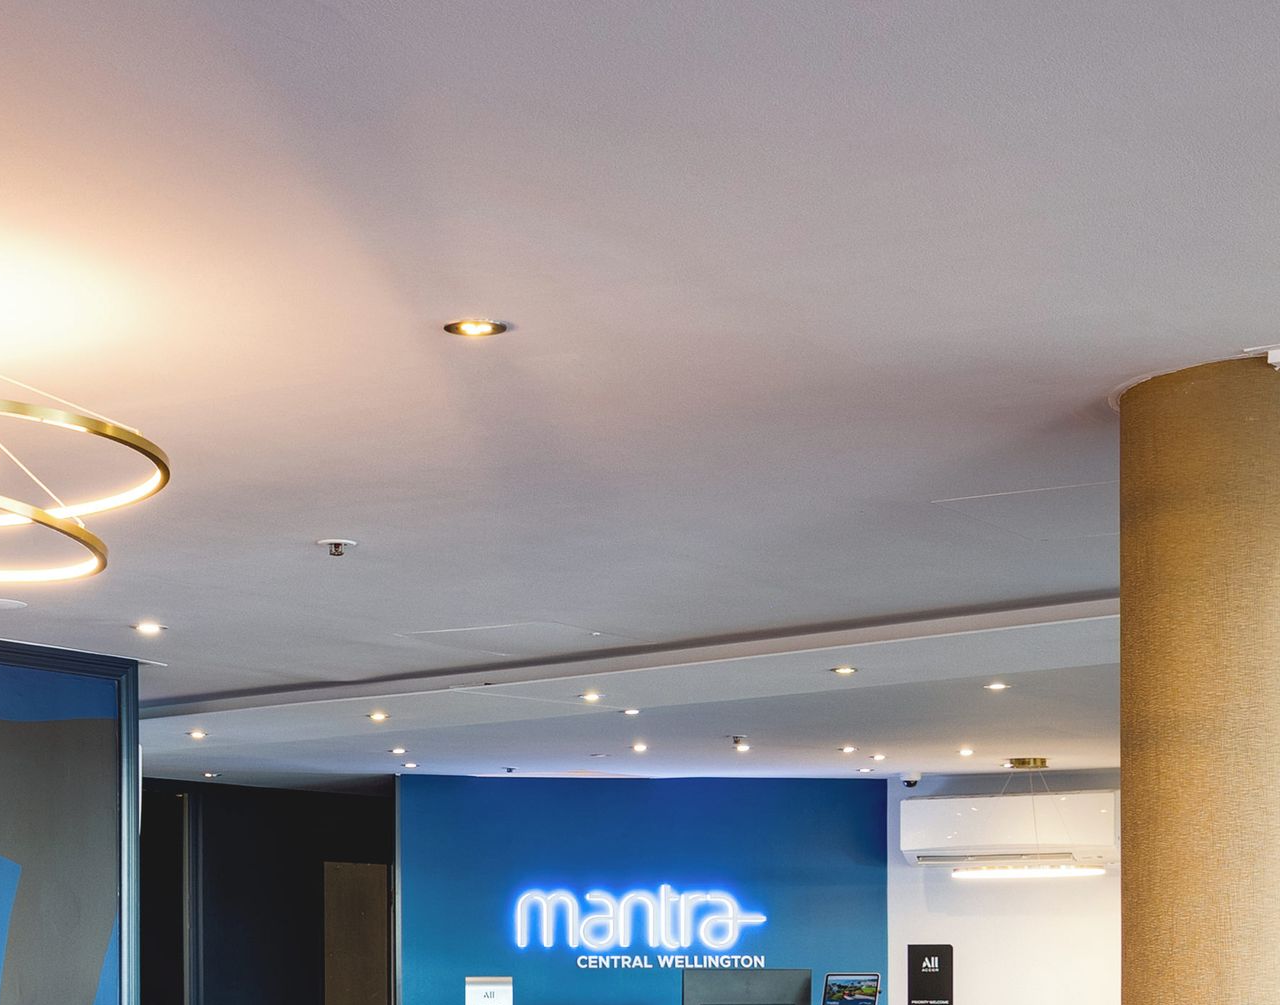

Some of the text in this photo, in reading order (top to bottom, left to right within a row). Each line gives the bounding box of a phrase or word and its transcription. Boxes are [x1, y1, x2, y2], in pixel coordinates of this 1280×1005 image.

[517, 884, 767, 949] mantra
[576, 955, 766, 969] CENTRAL WELLINGTON
